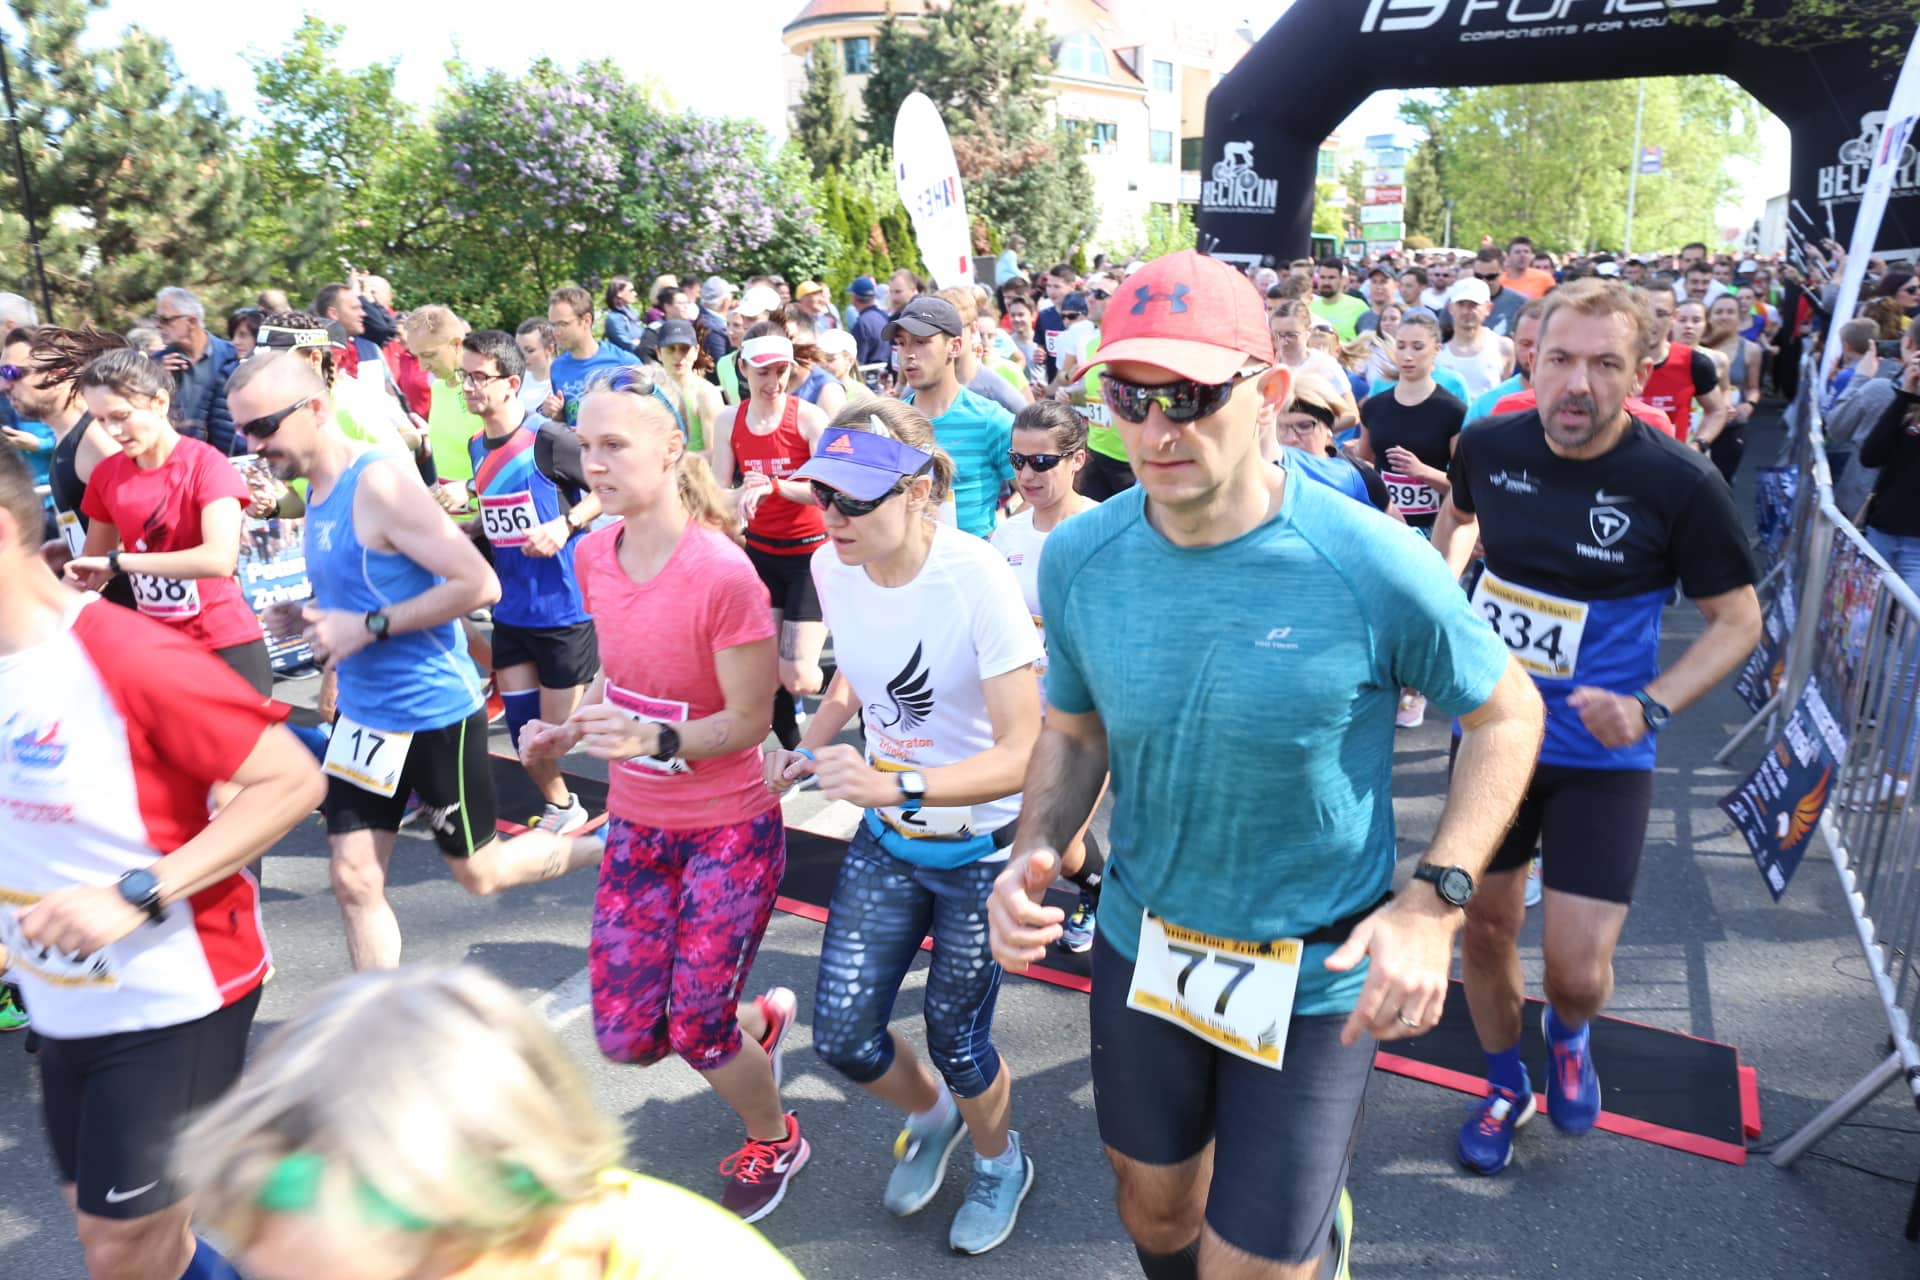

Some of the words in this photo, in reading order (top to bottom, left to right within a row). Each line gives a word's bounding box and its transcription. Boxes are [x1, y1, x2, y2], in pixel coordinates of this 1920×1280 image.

[1460, 25, 1578, 41] COMPONENTS
[1583, 20, 1624, 33] FOR
[484, 506, 531, 534] 556
[1483, 601, 1564, 662] 334
[351, 726, 386, 767] 17
[1167, 944, 1256, 1016] 77
